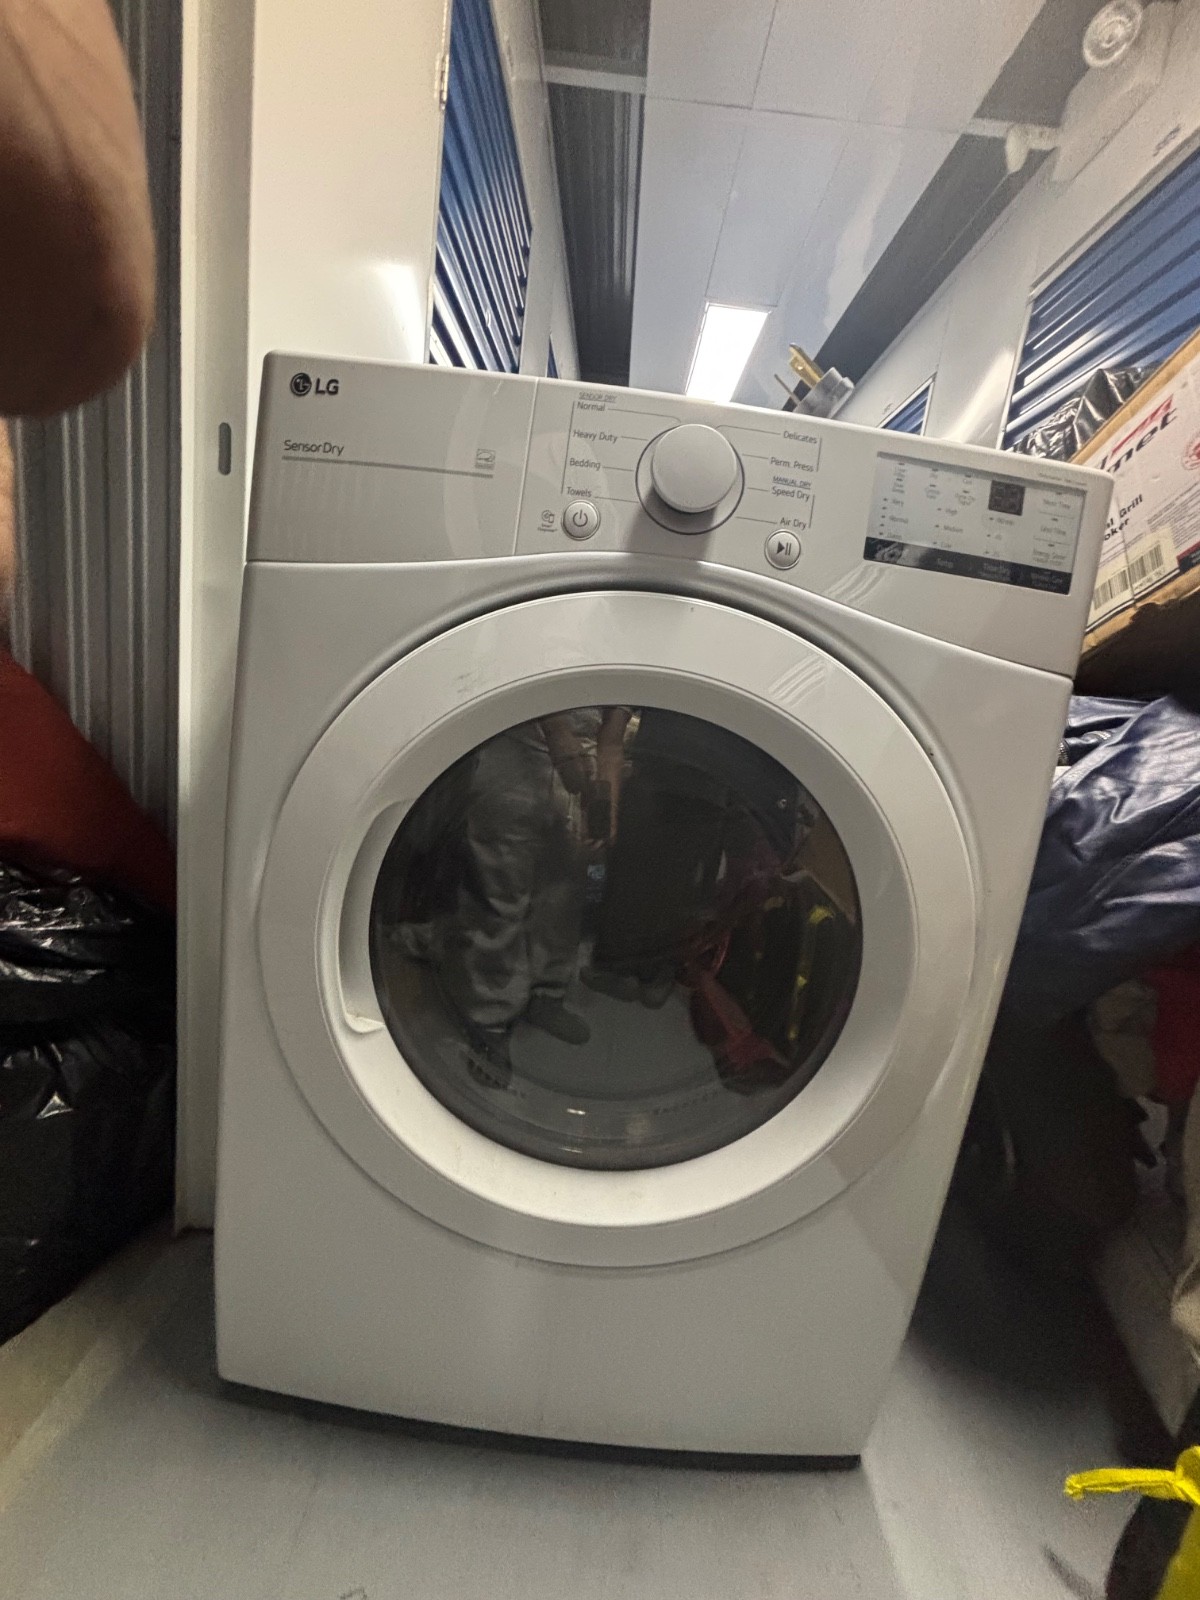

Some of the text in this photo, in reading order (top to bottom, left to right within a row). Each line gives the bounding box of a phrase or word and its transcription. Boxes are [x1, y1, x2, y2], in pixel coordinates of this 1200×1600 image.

[314, 377, 340, 396] LG
[576, 401, 606, 412] Normal
[573, 429, 619, 444] Heavy Duty
[783, 430, 818, 444] Delicates
[569, 457, 601, 472] Bedding
[770, 456, 814, 473] Perm. Press
[772, 475, 812, 489] MANUAL DRY
[566, 486, 593, 498] Towels
[771, 486, 811, 502] Speed Dry
[1119, 493, 1143, 518] Grill
[779, 517, 807, 531] Air Dry
